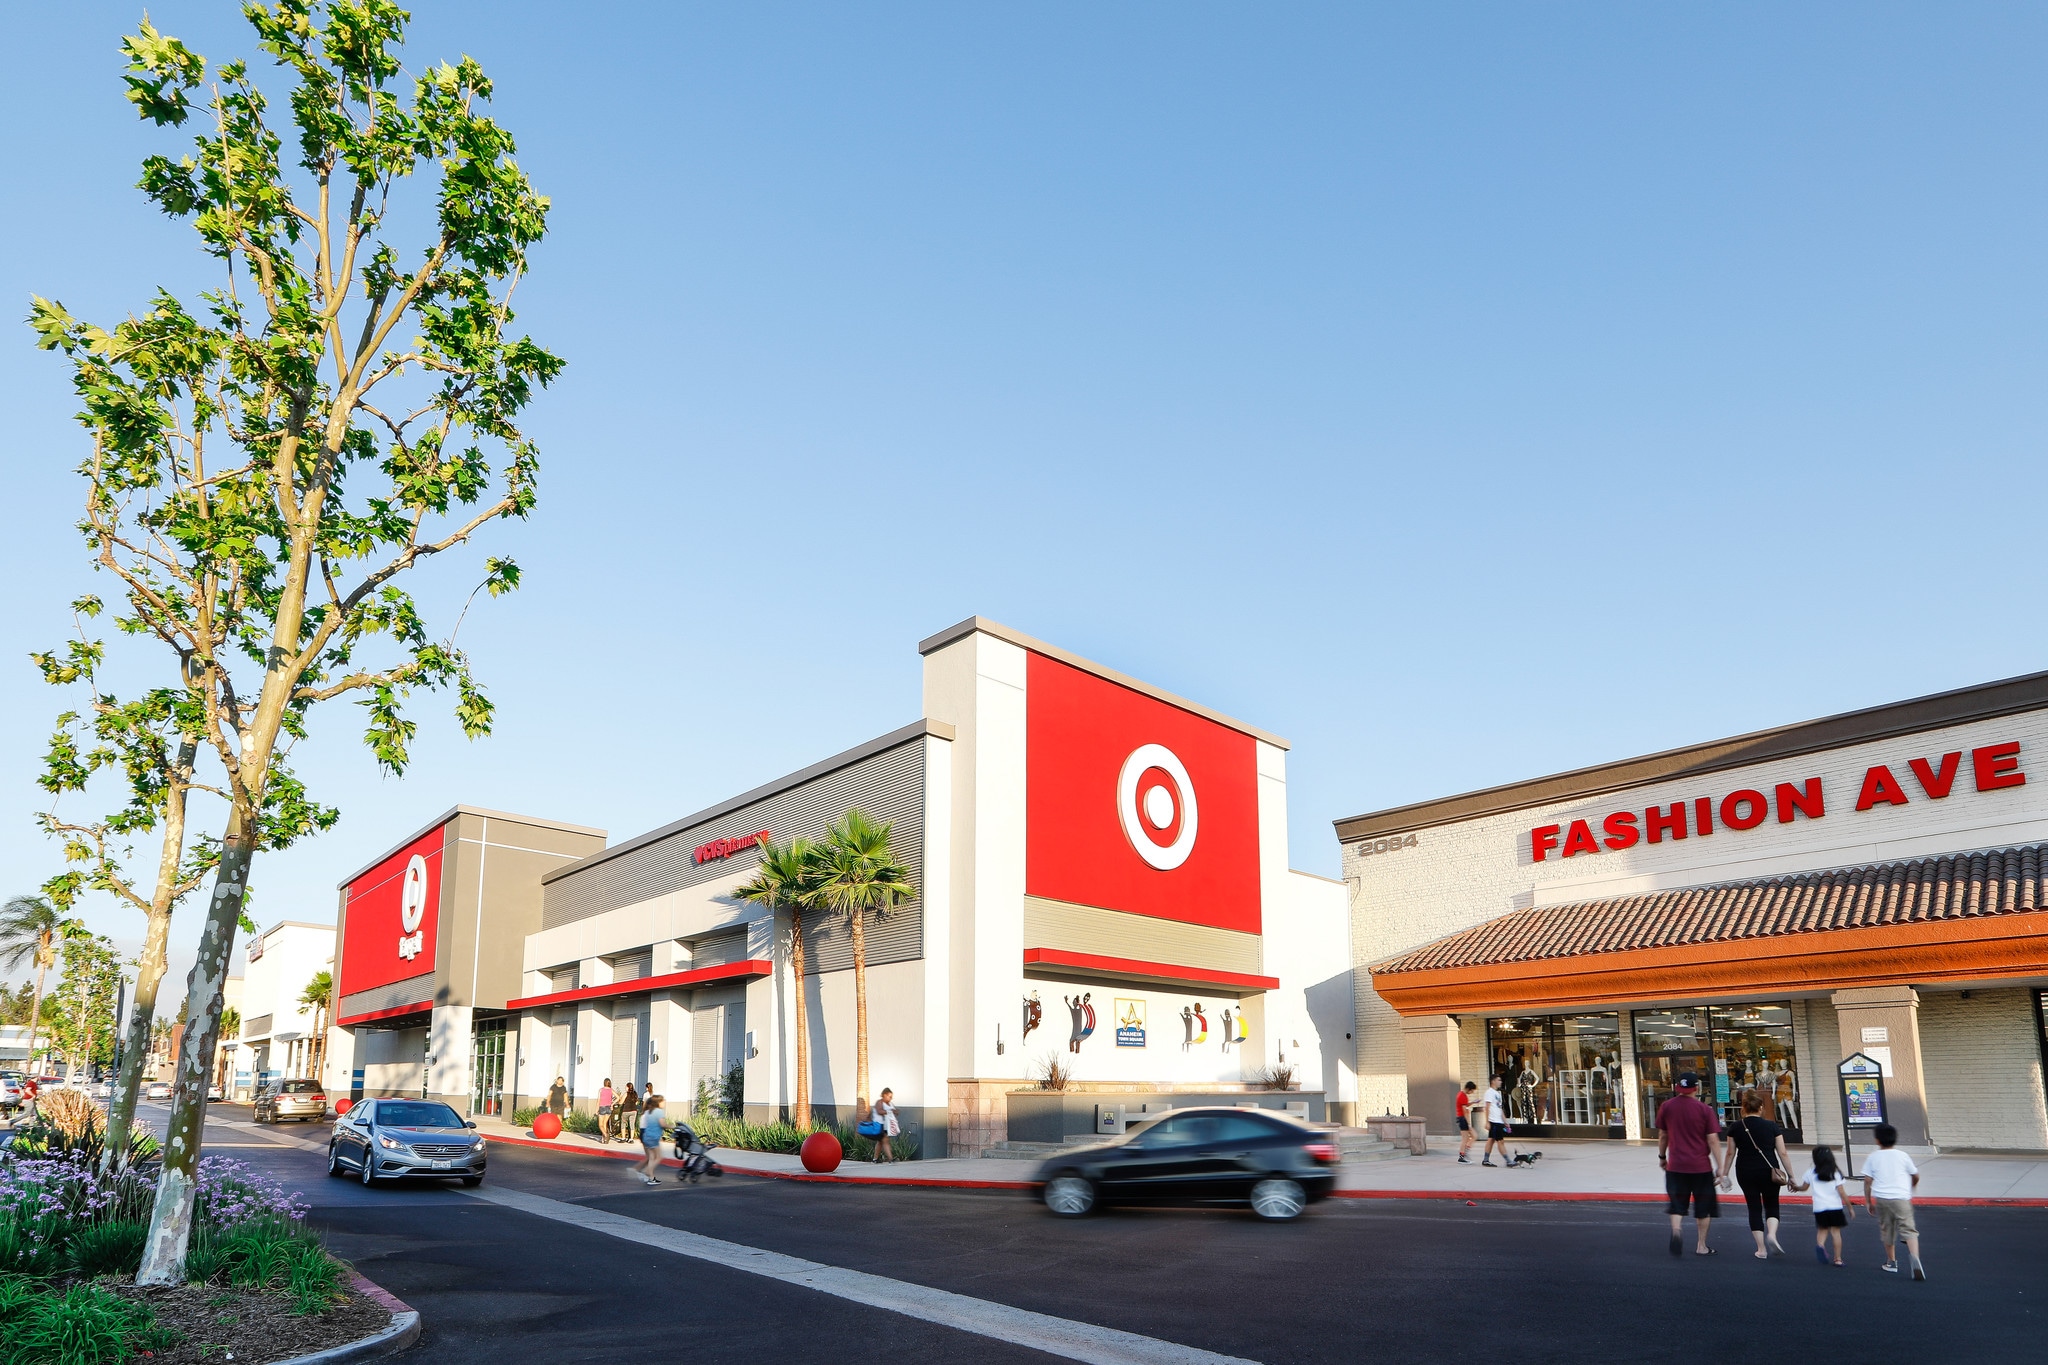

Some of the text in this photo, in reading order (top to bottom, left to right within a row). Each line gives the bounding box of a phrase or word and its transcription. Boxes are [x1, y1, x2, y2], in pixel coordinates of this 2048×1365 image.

[1531, 741, 2026, 862] FASHION AVE
[1358, 833, 1419, 857] 2084
[1662, 1042, 1683, 1051] 2084
